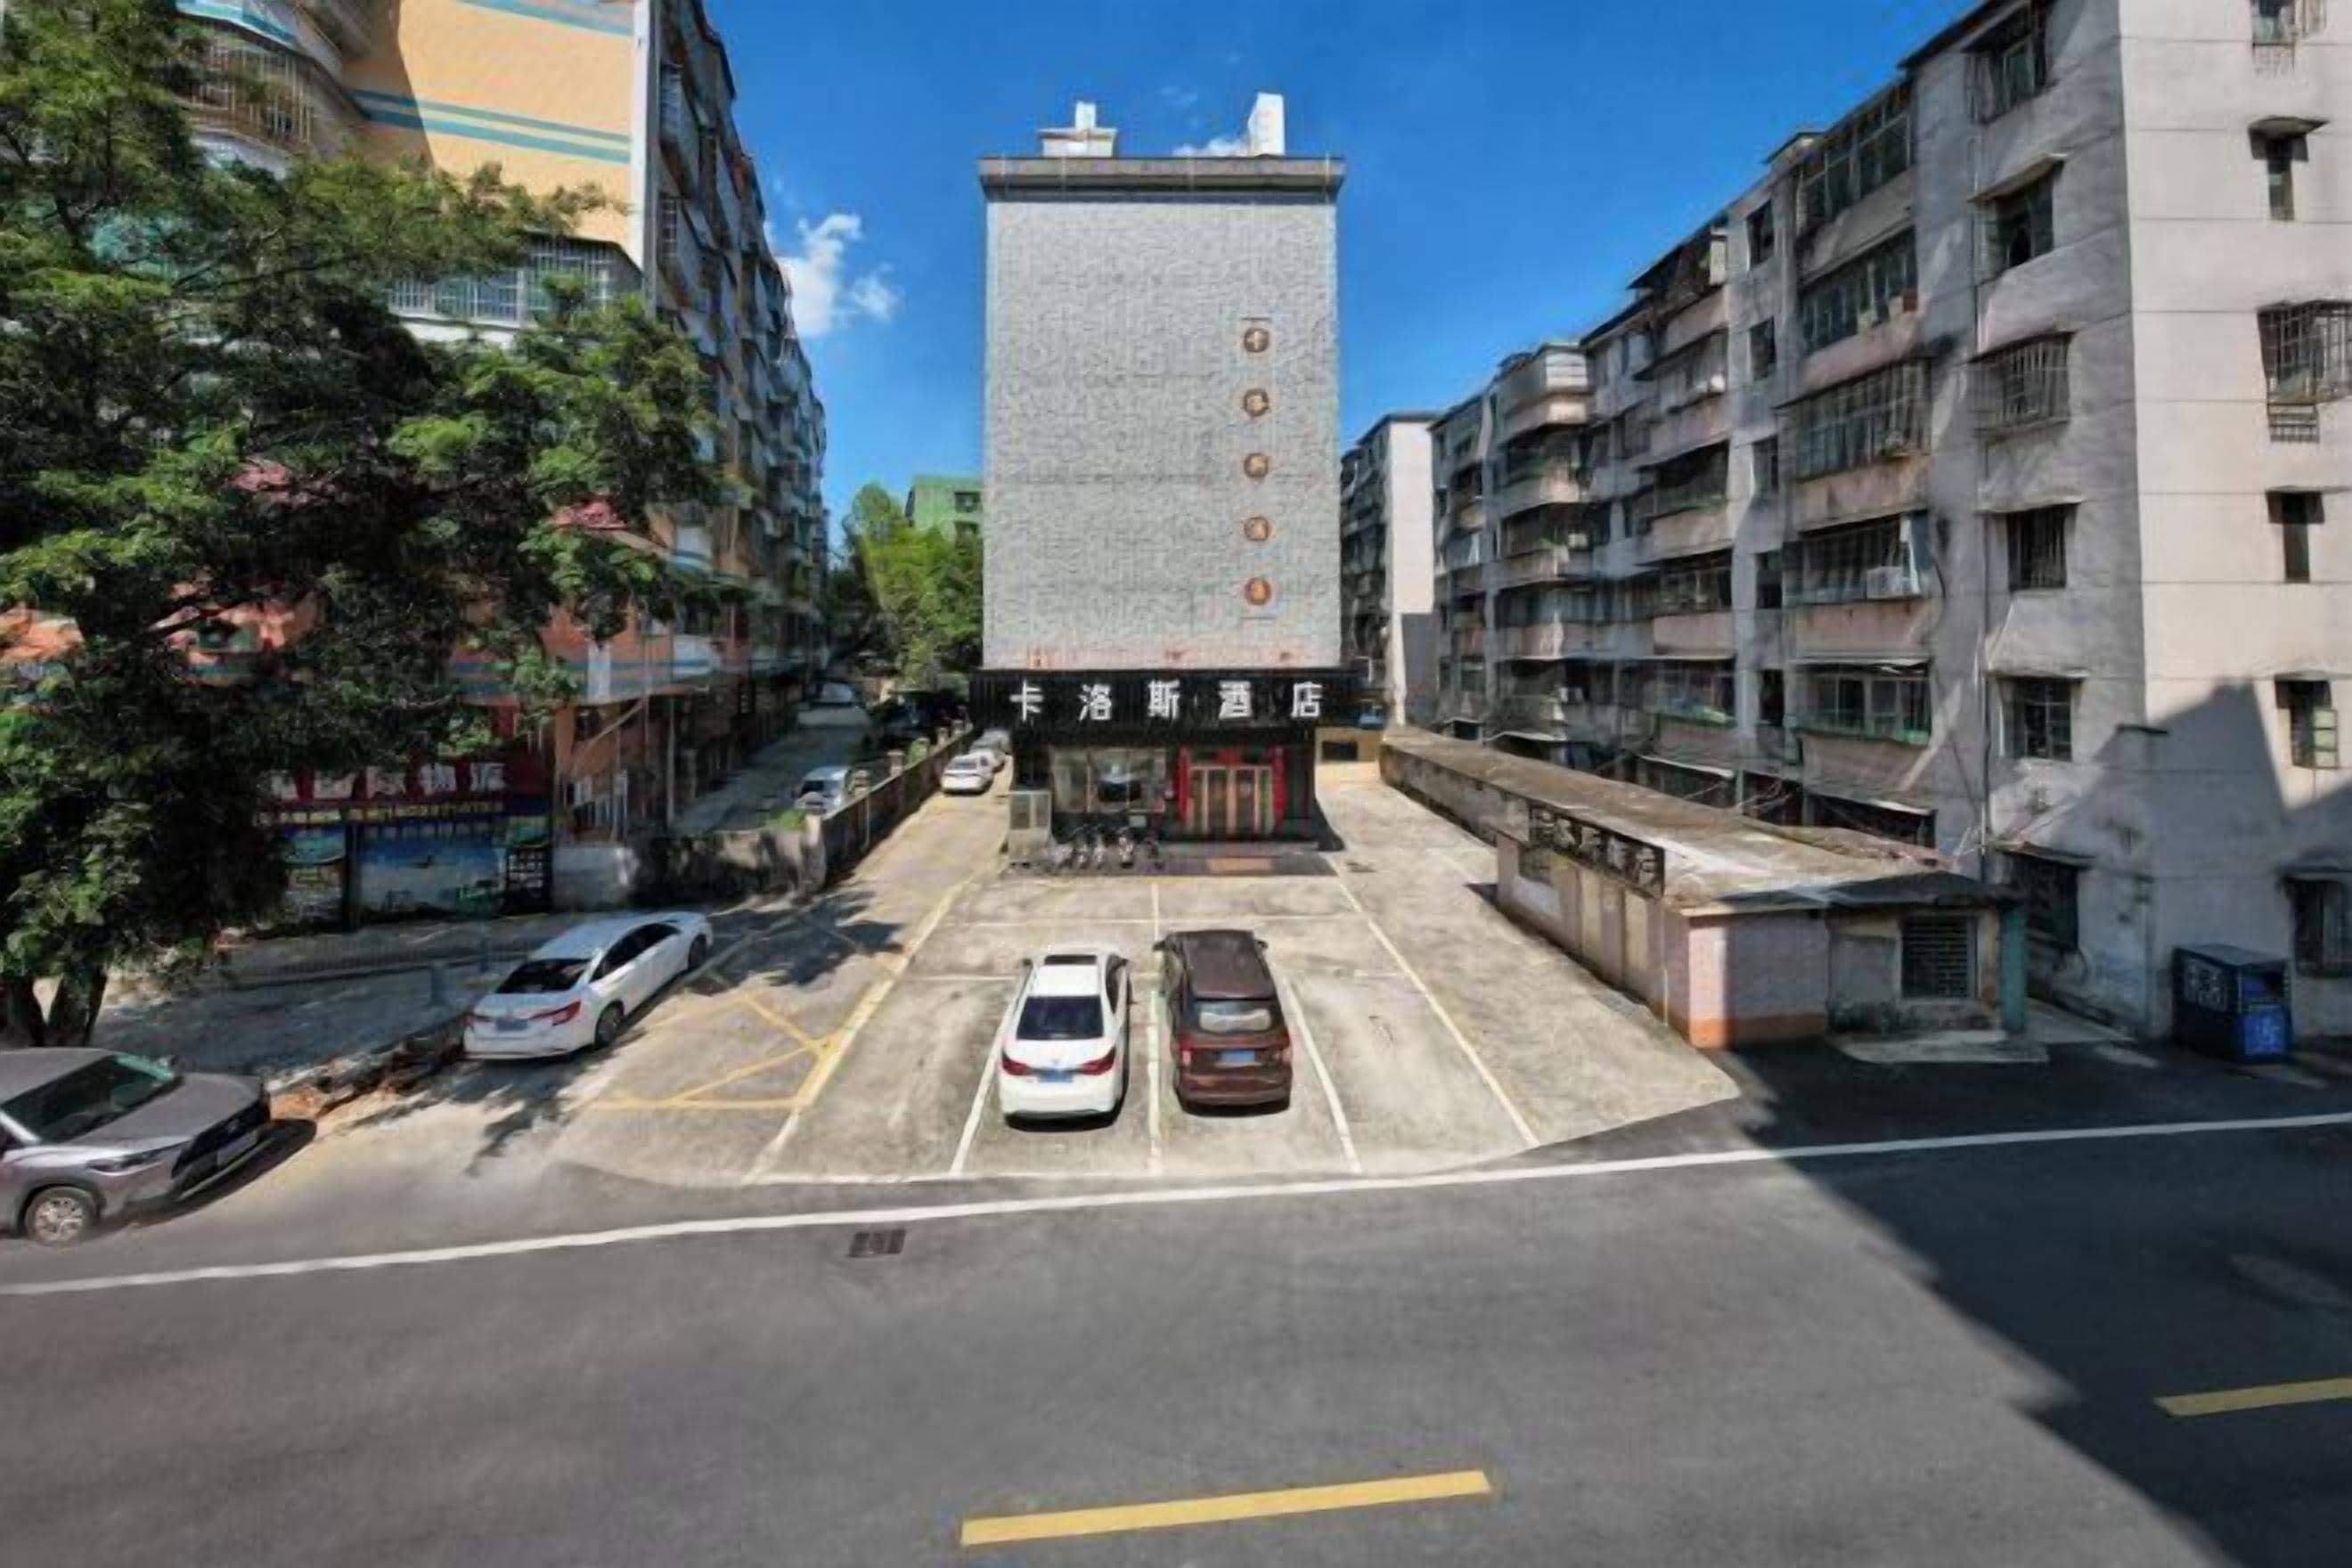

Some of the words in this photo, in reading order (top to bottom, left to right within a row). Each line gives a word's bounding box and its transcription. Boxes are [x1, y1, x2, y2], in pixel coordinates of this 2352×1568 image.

[1009, 680, 1323, 721] 卡洛斯酒店
